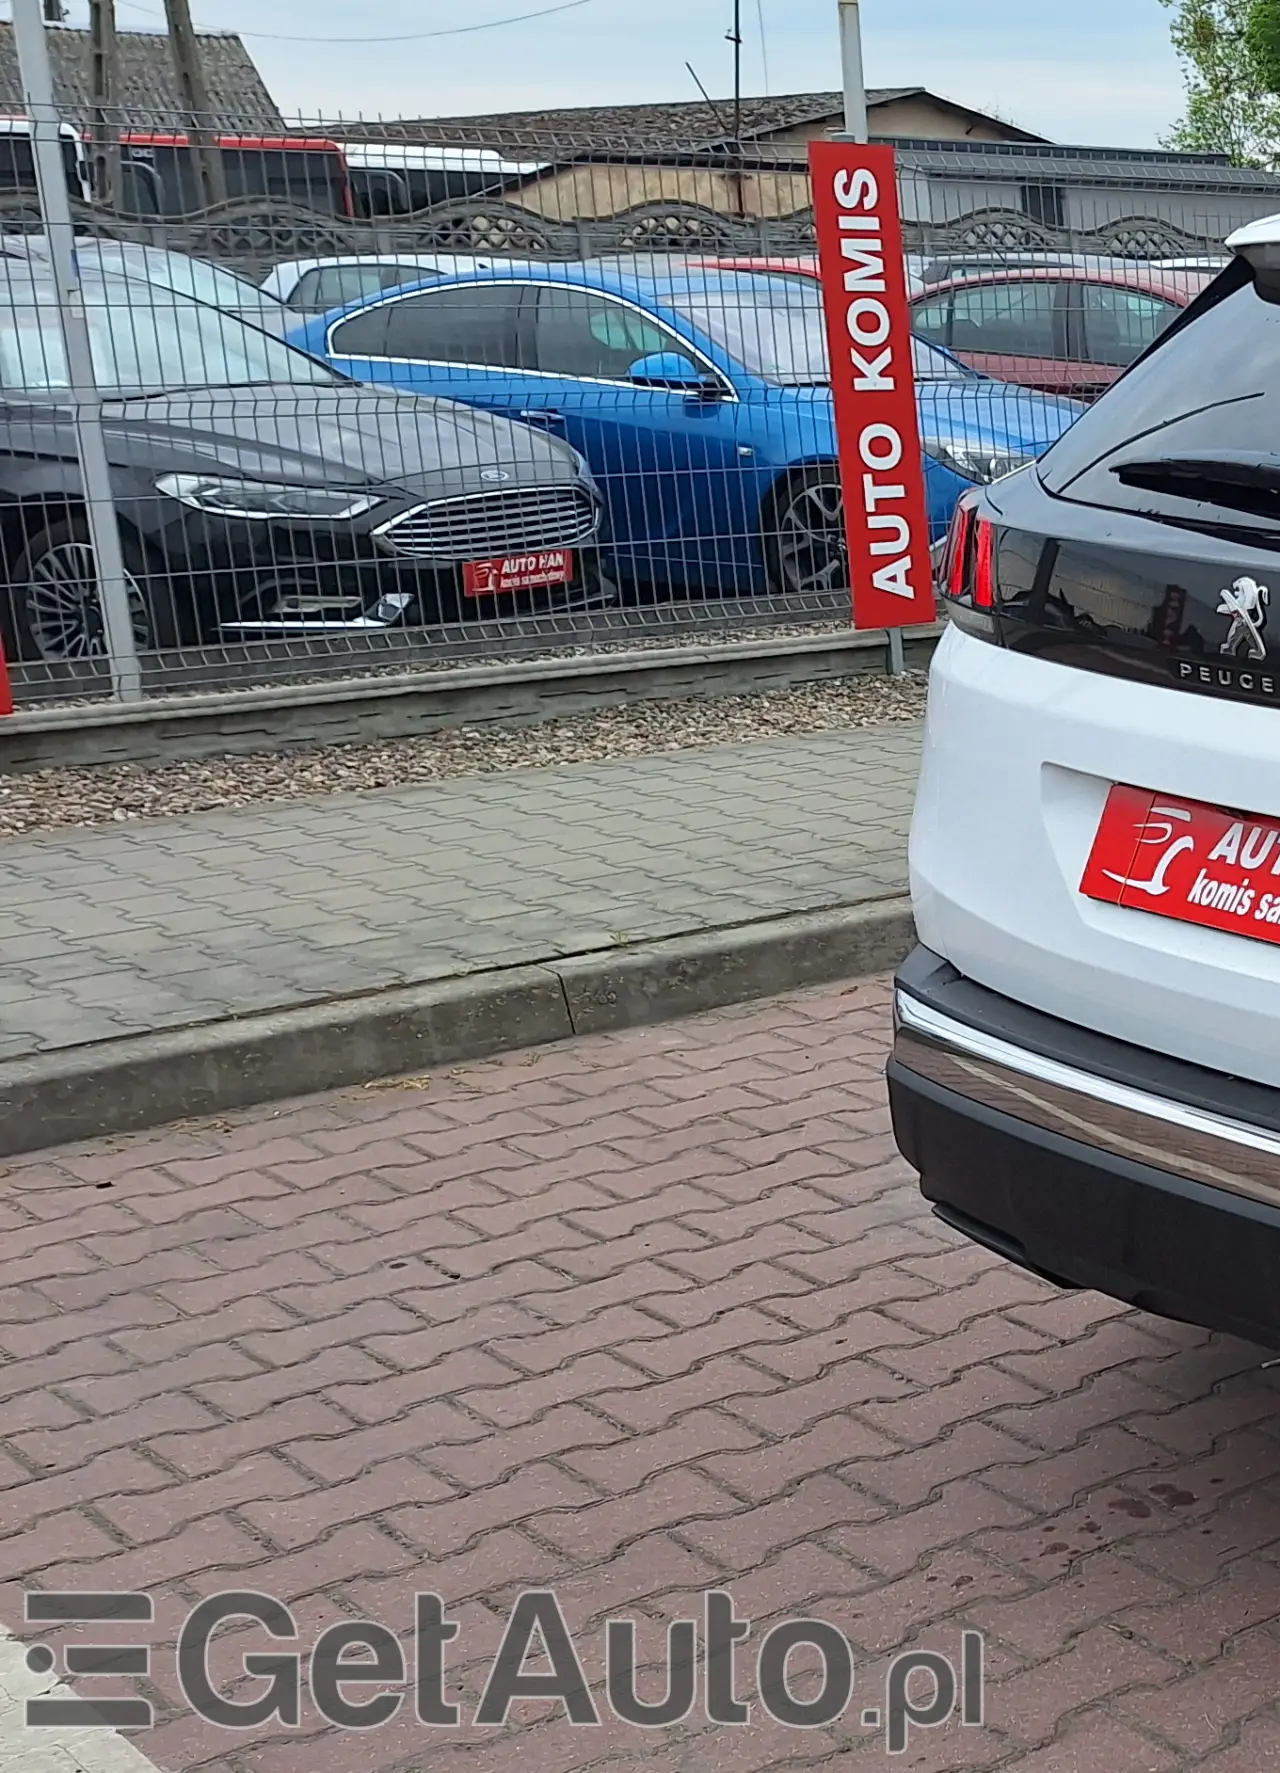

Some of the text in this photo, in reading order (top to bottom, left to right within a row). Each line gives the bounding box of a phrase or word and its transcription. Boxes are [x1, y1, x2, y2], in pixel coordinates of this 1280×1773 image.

[833, 167, 916, 600] AUTO KOMIS
[501, 553, 564, 574] AUTO HAN
[1187, 868, 1256, 916] komis
